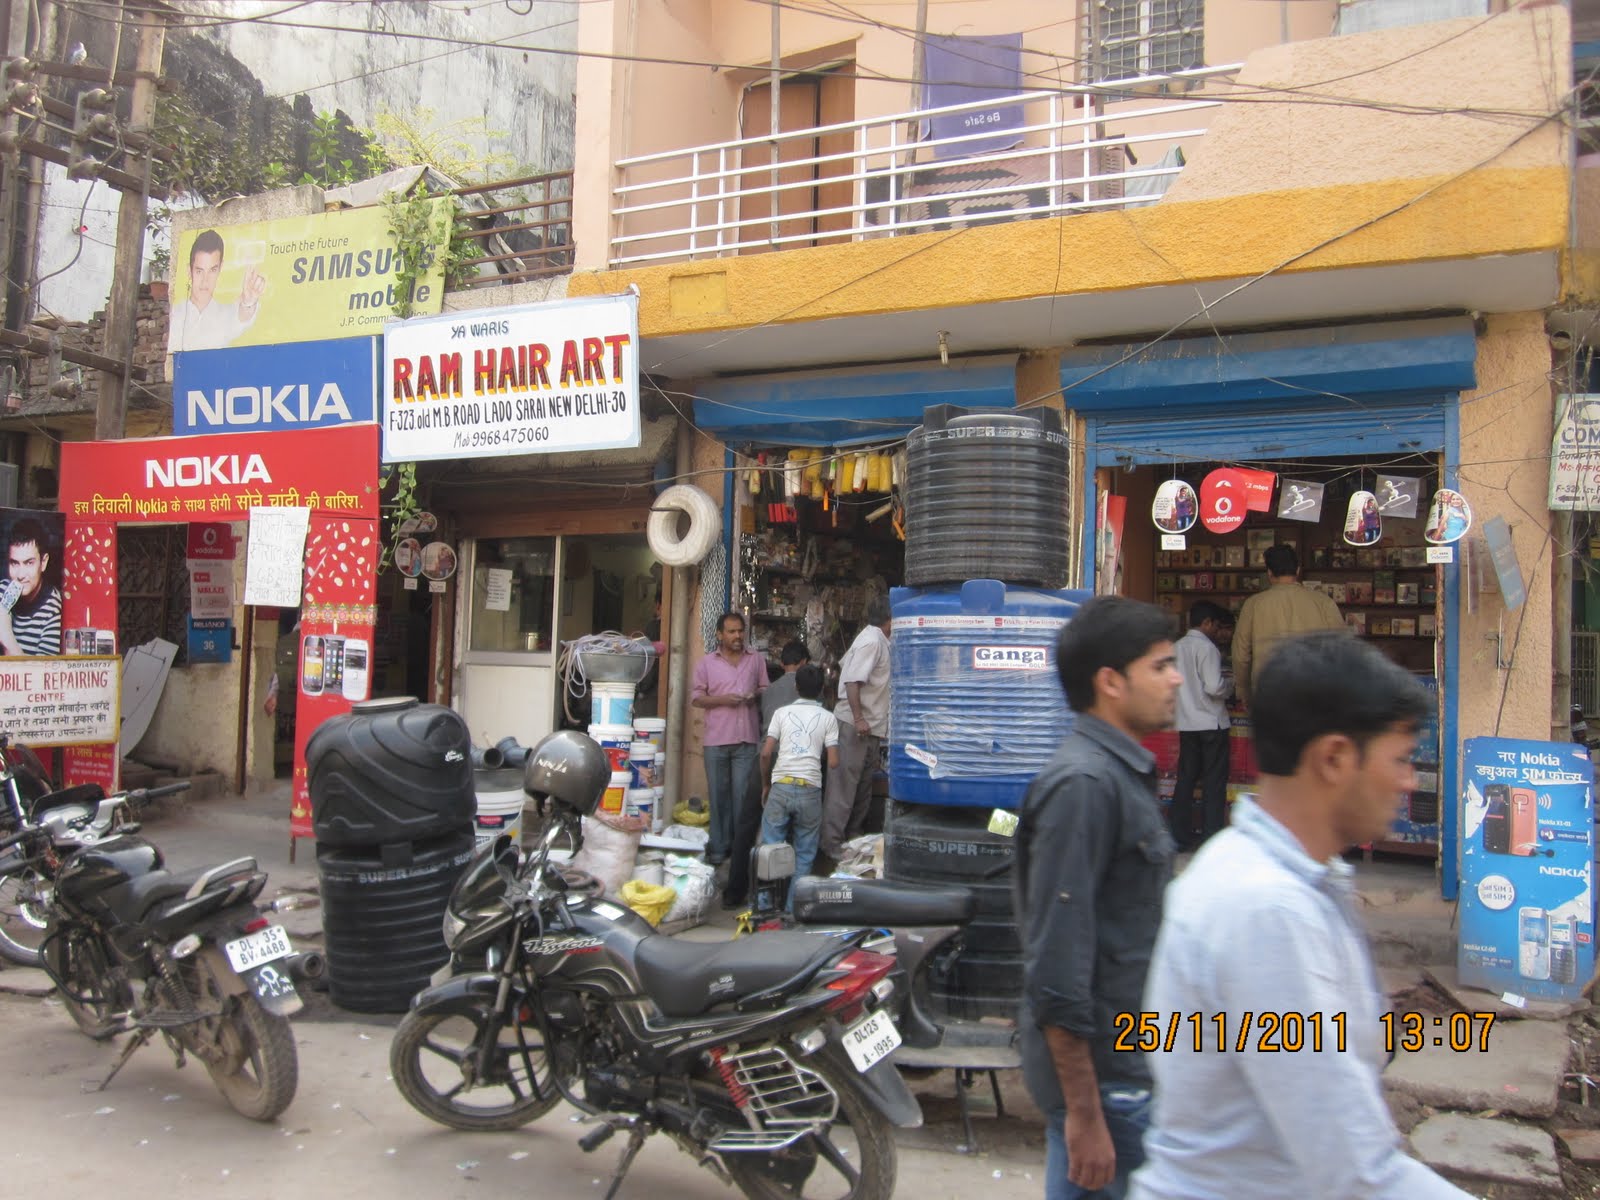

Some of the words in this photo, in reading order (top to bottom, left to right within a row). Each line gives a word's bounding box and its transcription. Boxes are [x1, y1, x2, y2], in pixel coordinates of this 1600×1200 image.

[270, 243, 297, 255] Touch
[299, 240, 315, 253] the
[317, 236, 349, 251] future
[348, 278, 430, 310] moble
[340, 316, 355, 327] J.P.
[451, 325, 466, 339] YA
[470, 320, 509, 337] WARIS
[393, 352, 463, 404] RAM
[474, 343, 552, 395] HAIR
[559, 333, 630, 389] ART
[187, 383, 352, 426] NOKIA
[453, 403, 480, 426] ROAD
[484, 400, 512, 424] LADO
[516, 399, 547, 421] SARAI
[549, 395, 572, 418] NEW
[575, 391, 627, 416] DELHI-30
[472, 427, 549, 447] 9968475060
[948, 427, 996, 439] SUPER
[146, 454, 272, 488] NOKIA
[74, 501, 90, 514] इस
[92, 492, 132, 514] दिवाली
[135, 499, 168, 514] Nokia
[171, 495, 181, 512] के
[185, 500, 206, 512] साथ
[209, 493, 231, 511] होगी
[305, 495, 320, 510] की
[1206, 515, 1241, 523] vodafone
[203, 641, 214, 650] 3G
[976, 648, 1045, 663] Ganga
[0, 672, 32, 692] OBILE
[43, 671, 108, 690] REPAIRING
[28, 692, 65, 703] CENTRE
[1497, 751, 1516, 764] नए
[1520, 752, 1560, 766] Nokia
[1522, 768, 1545, 780] SIM
[928, 841, 978, 856] SUPER
[359, 869, 407, 884] SUPER
[1540, 866, 1587, 878] NOKIA
[260, 941, 286, 957] 4488
